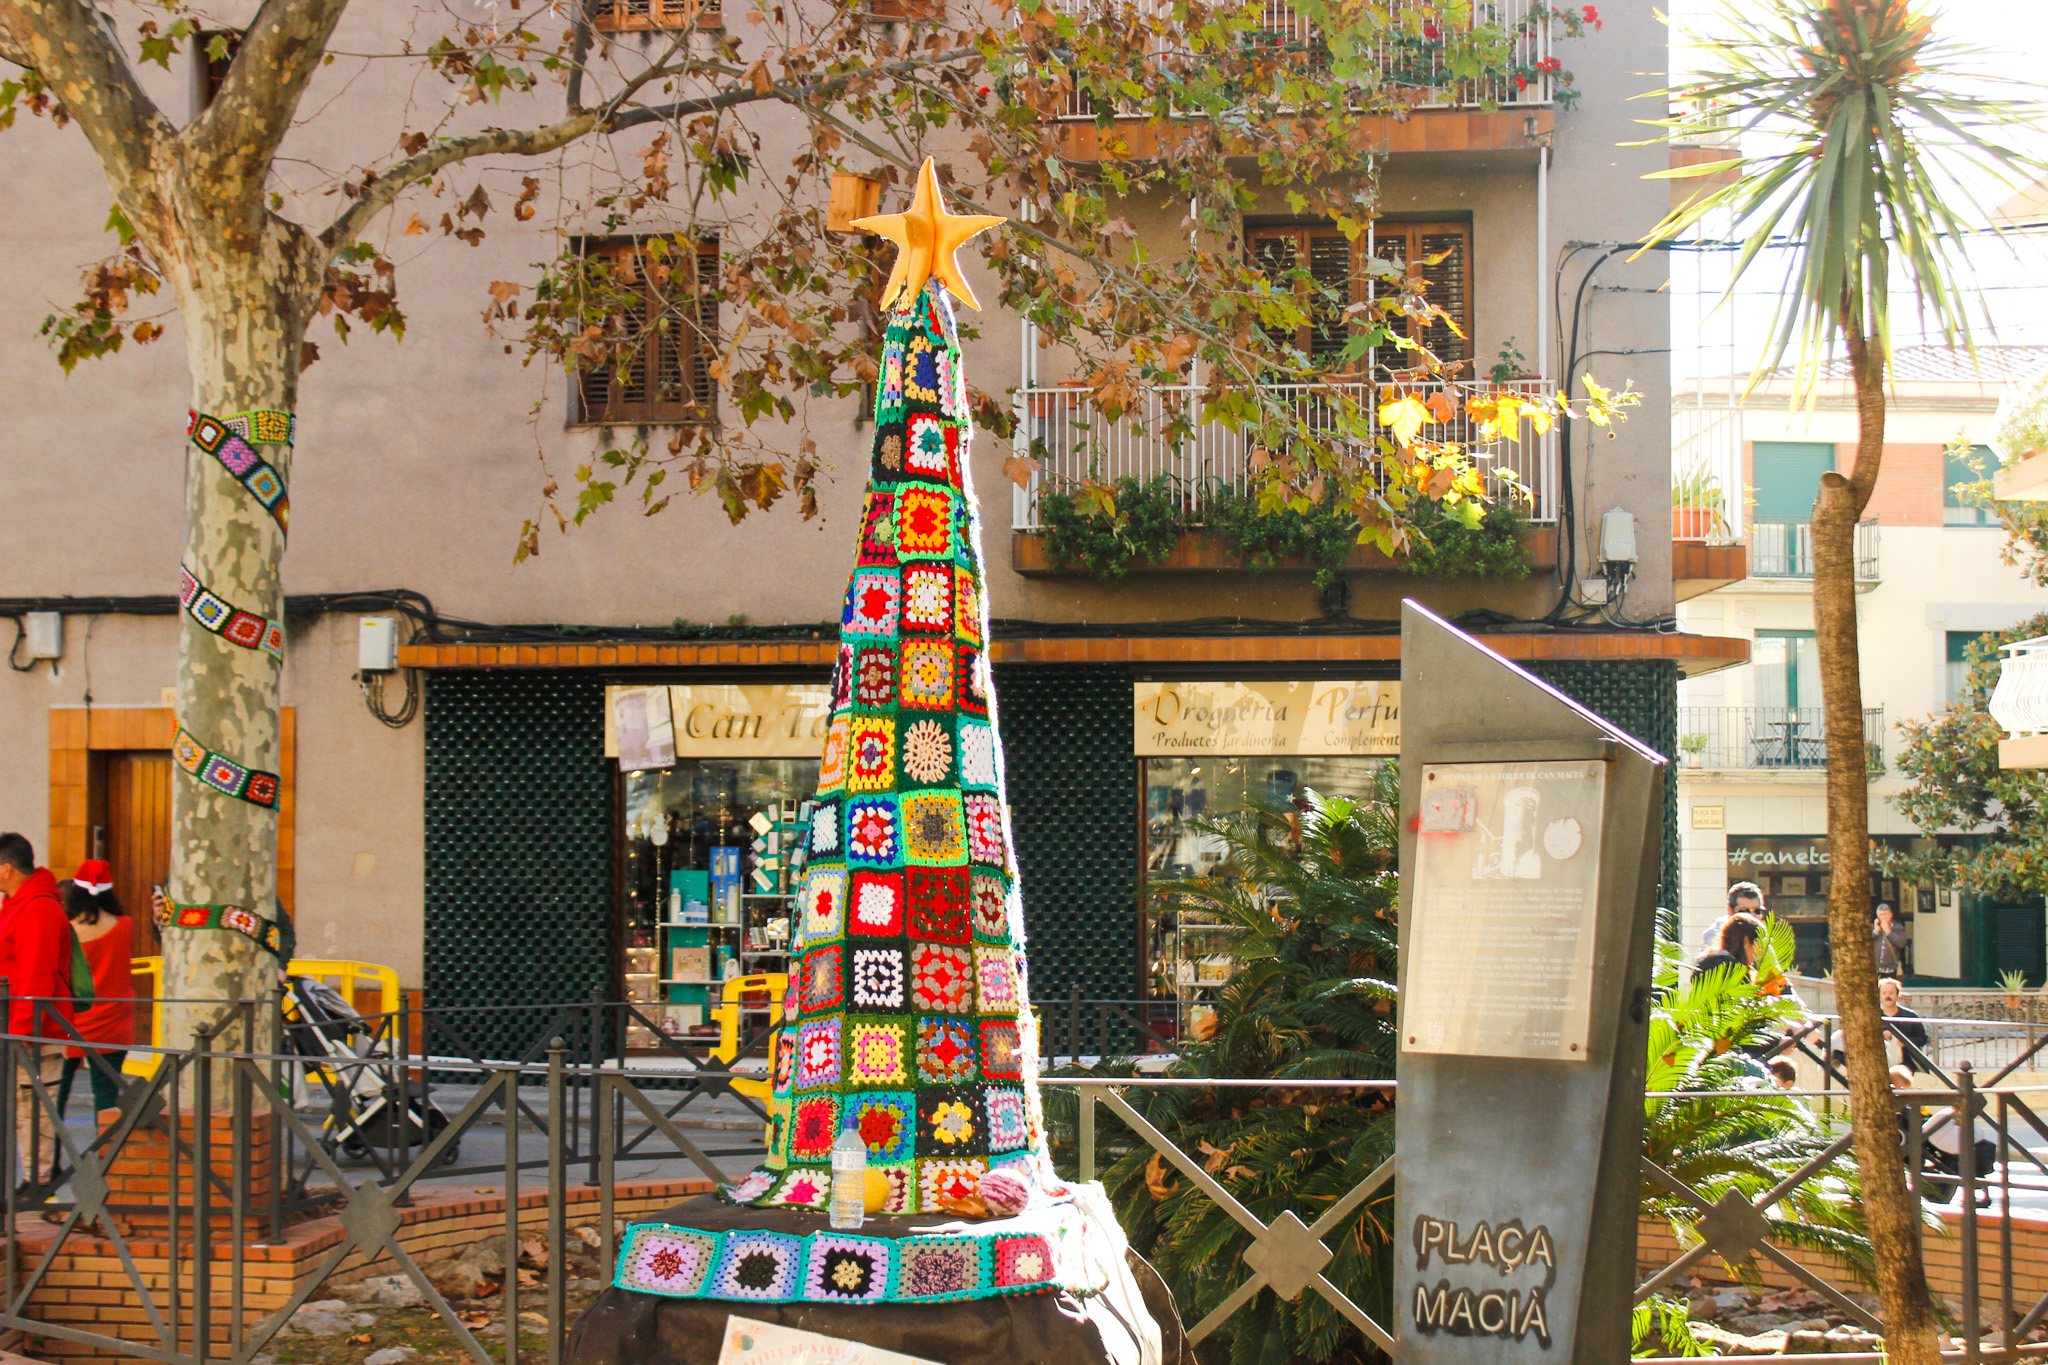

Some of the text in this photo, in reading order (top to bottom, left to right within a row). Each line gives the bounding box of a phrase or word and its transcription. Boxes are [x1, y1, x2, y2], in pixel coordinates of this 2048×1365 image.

[683, 702, 772, 739] Can
[1315, 686, 1399, 728] Perfu
[1152, 731, 1218, 748] Productes
[1324, 730, 1400, 751] Complement
[1498, 772, 1524, 780] TORRE
[1526, 772, 1536, 780] DE
[1538, 771, 1555, 779] CAN
[1420, 1221, 1553, 1274] PLAÇA
[1415, 1286, 1548, 1338] MACIÀ
